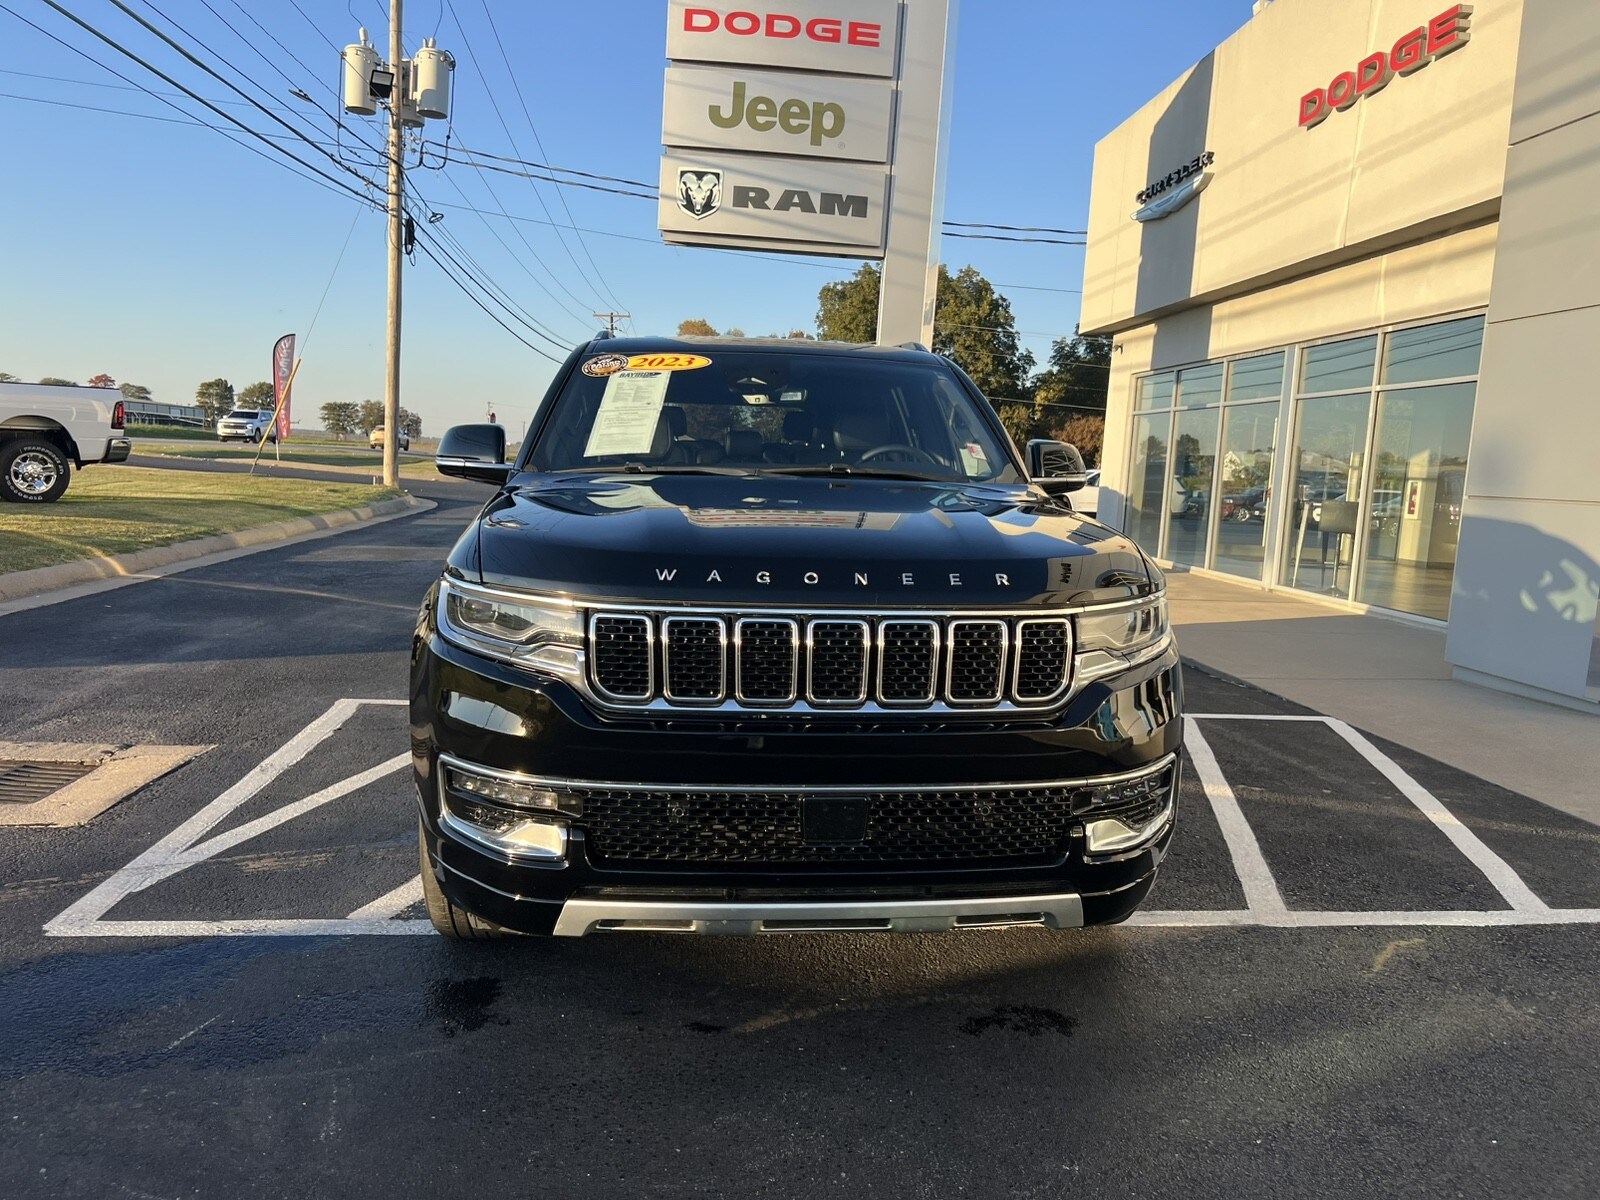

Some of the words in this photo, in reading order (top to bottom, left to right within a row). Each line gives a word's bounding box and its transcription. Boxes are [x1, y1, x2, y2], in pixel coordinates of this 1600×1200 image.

[683, 8, 881, 47] DODGE
[1299, 4, 1471, 128] DODGE
[708, 81, 845, 146] Jeep
[732, 185, 868, 218] RAM
[631, 357, 696, 367] 2023
[655, 568, 1010, 586] WAGONEER
